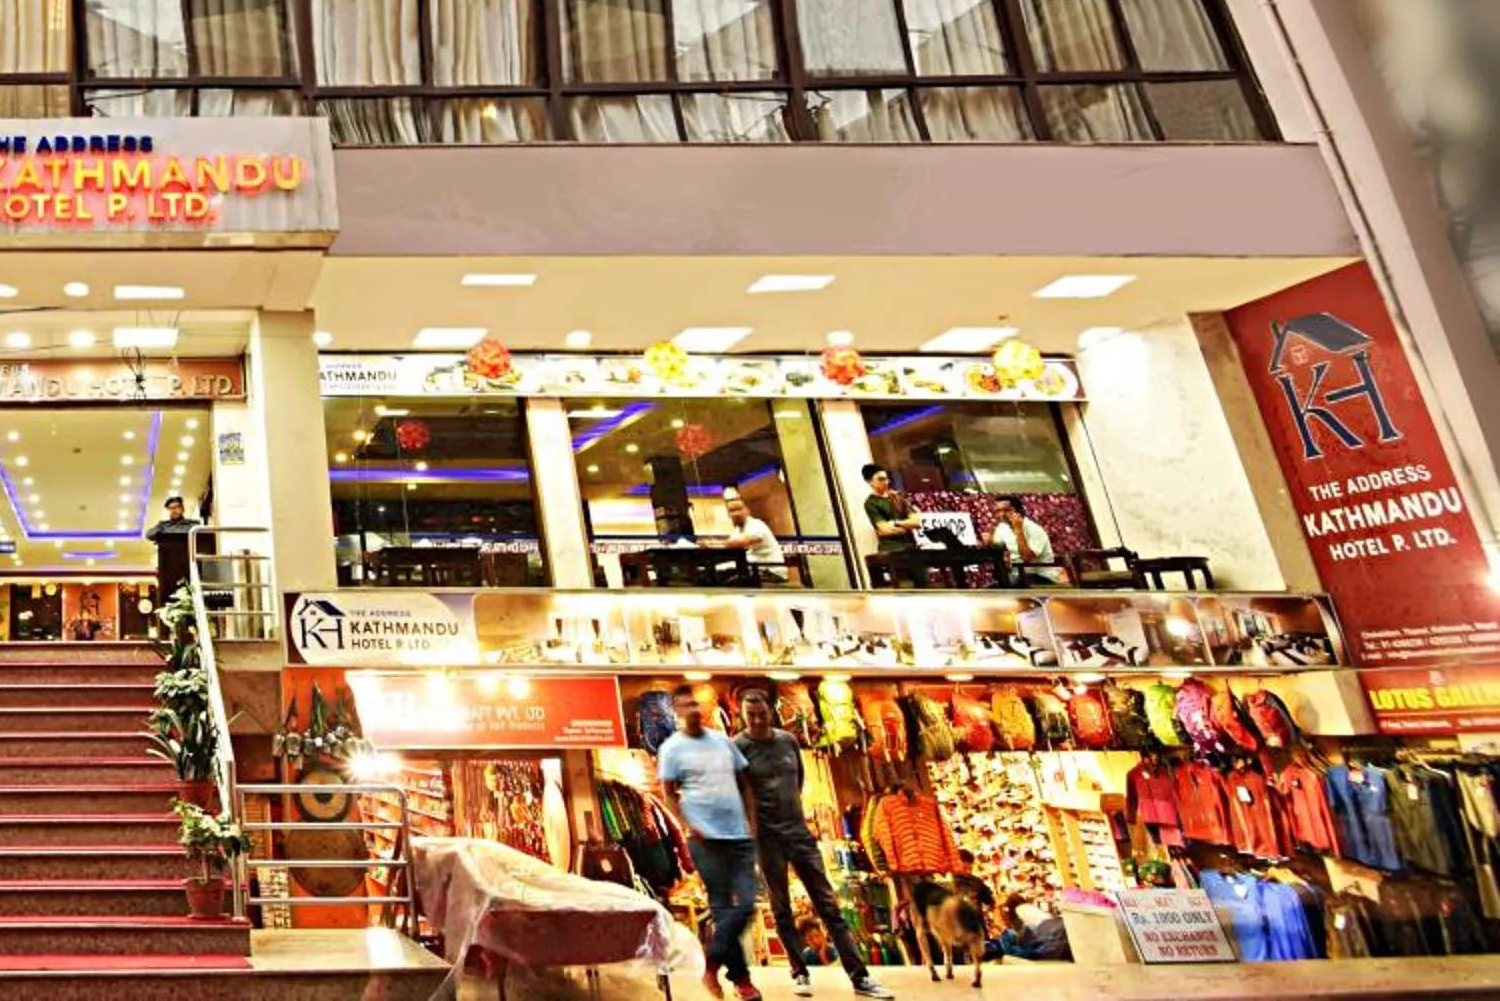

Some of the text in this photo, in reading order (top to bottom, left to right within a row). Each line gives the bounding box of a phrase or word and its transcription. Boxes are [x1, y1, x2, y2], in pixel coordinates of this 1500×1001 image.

[35, 135, 153, 153] ADDRESS
[105, 193, 135, 221] P.
[147, 192, 216, 220] LTD.
[318, 370, 397, 382] ATHMANDU
[1308, 464, 1432, 502] THE ADDRESS
[1303, 486, 1462, 538] KATHMANDU
[1329, 527, 1458, 562] HOTEL P. LTD.
[351, 620, 459, 637] KATHMANDU
[351, 638, 394, 650] HOTEL
[1368, 687, 1435, 710] LOTUS
[1182, 911, 1213, 923] ONLY
